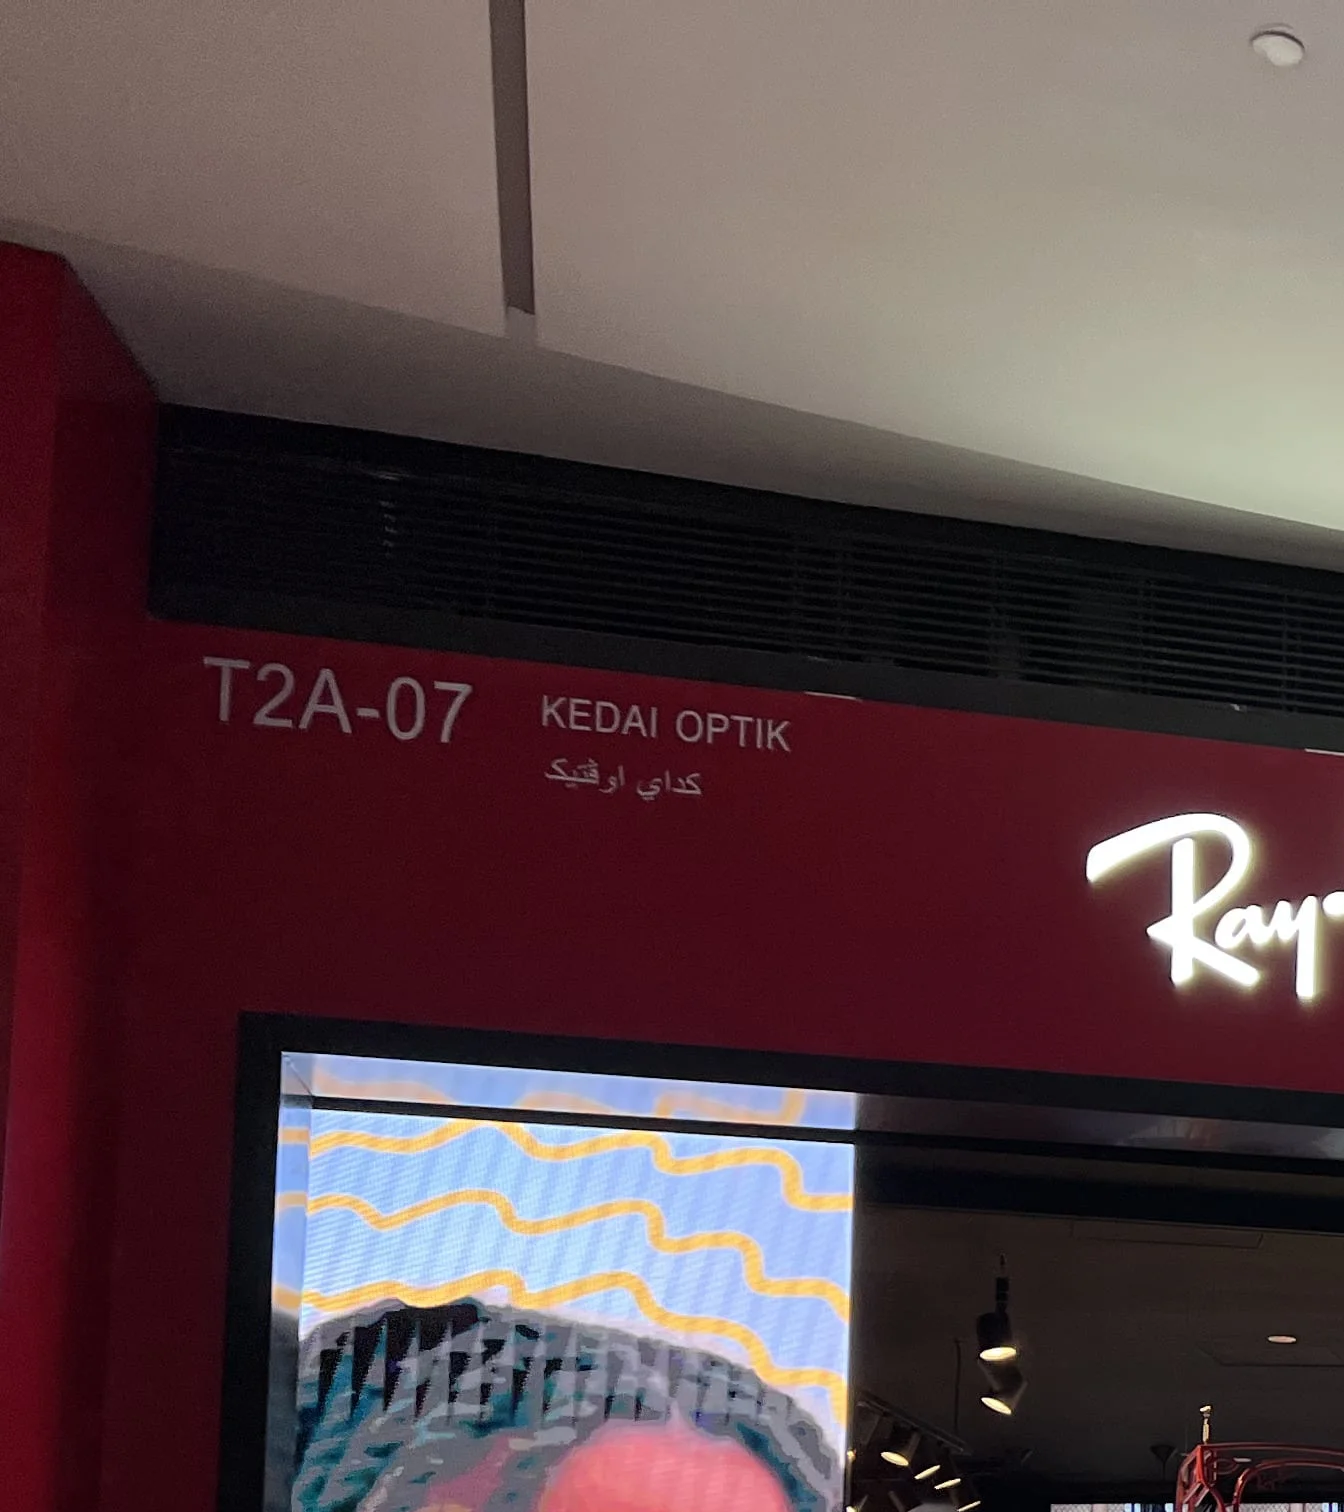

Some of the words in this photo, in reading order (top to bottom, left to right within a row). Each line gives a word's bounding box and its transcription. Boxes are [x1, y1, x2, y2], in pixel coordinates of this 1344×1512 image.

[203, 656, 473, 744] T2A-07
[541, 695, 657, 739] KEDAI
[675, 708, 792, 752] OPTIK
